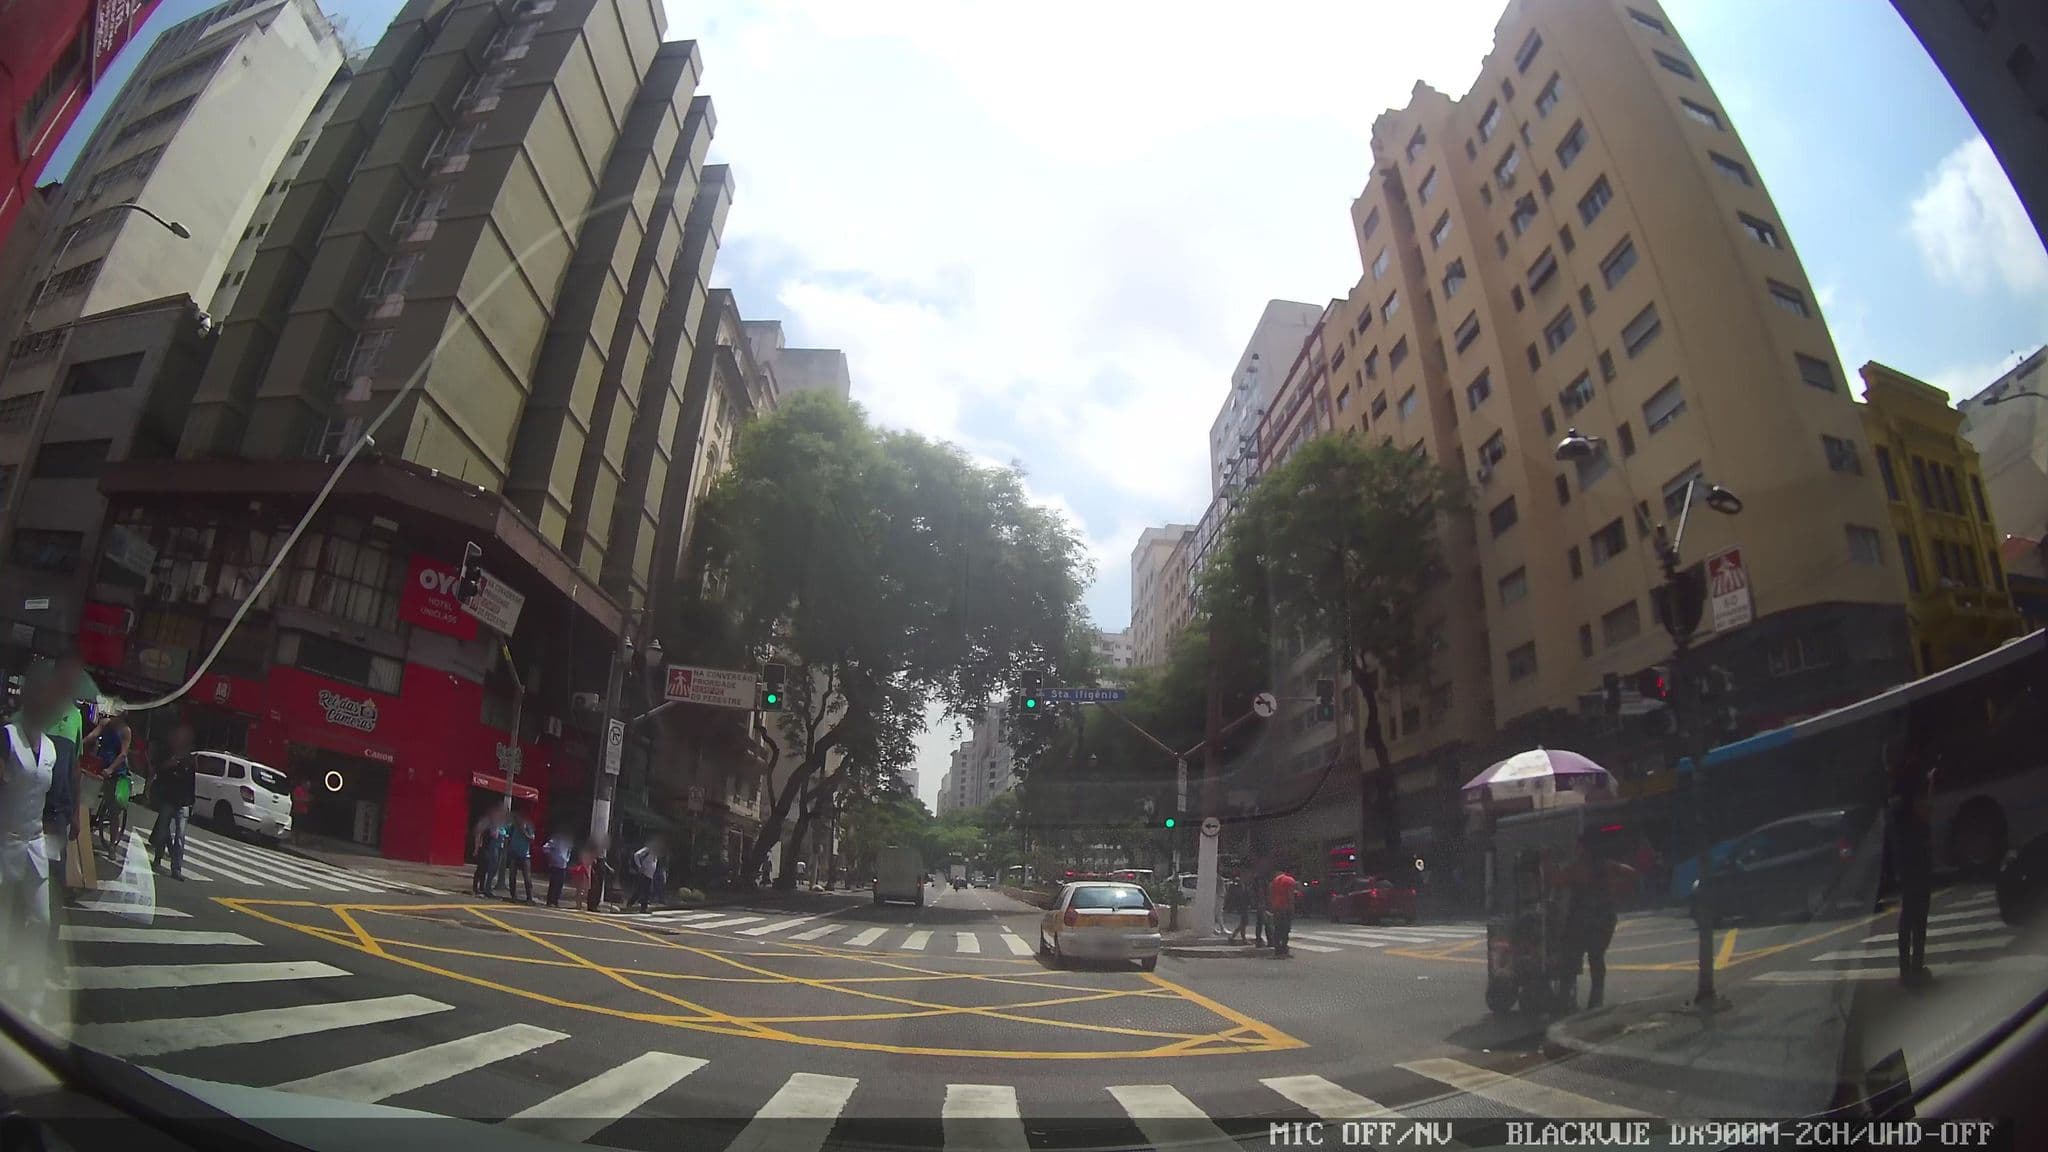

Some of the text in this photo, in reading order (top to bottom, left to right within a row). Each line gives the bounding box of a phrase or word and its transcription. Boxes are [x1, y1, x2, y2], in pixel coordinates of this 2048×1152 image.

[428, 597, 452, 611] HOTEL
[420, 608, 457, 625] UNICLASS
[319, 690, 358, 714] Rei das
[364, 749, 394, 762] Canon
